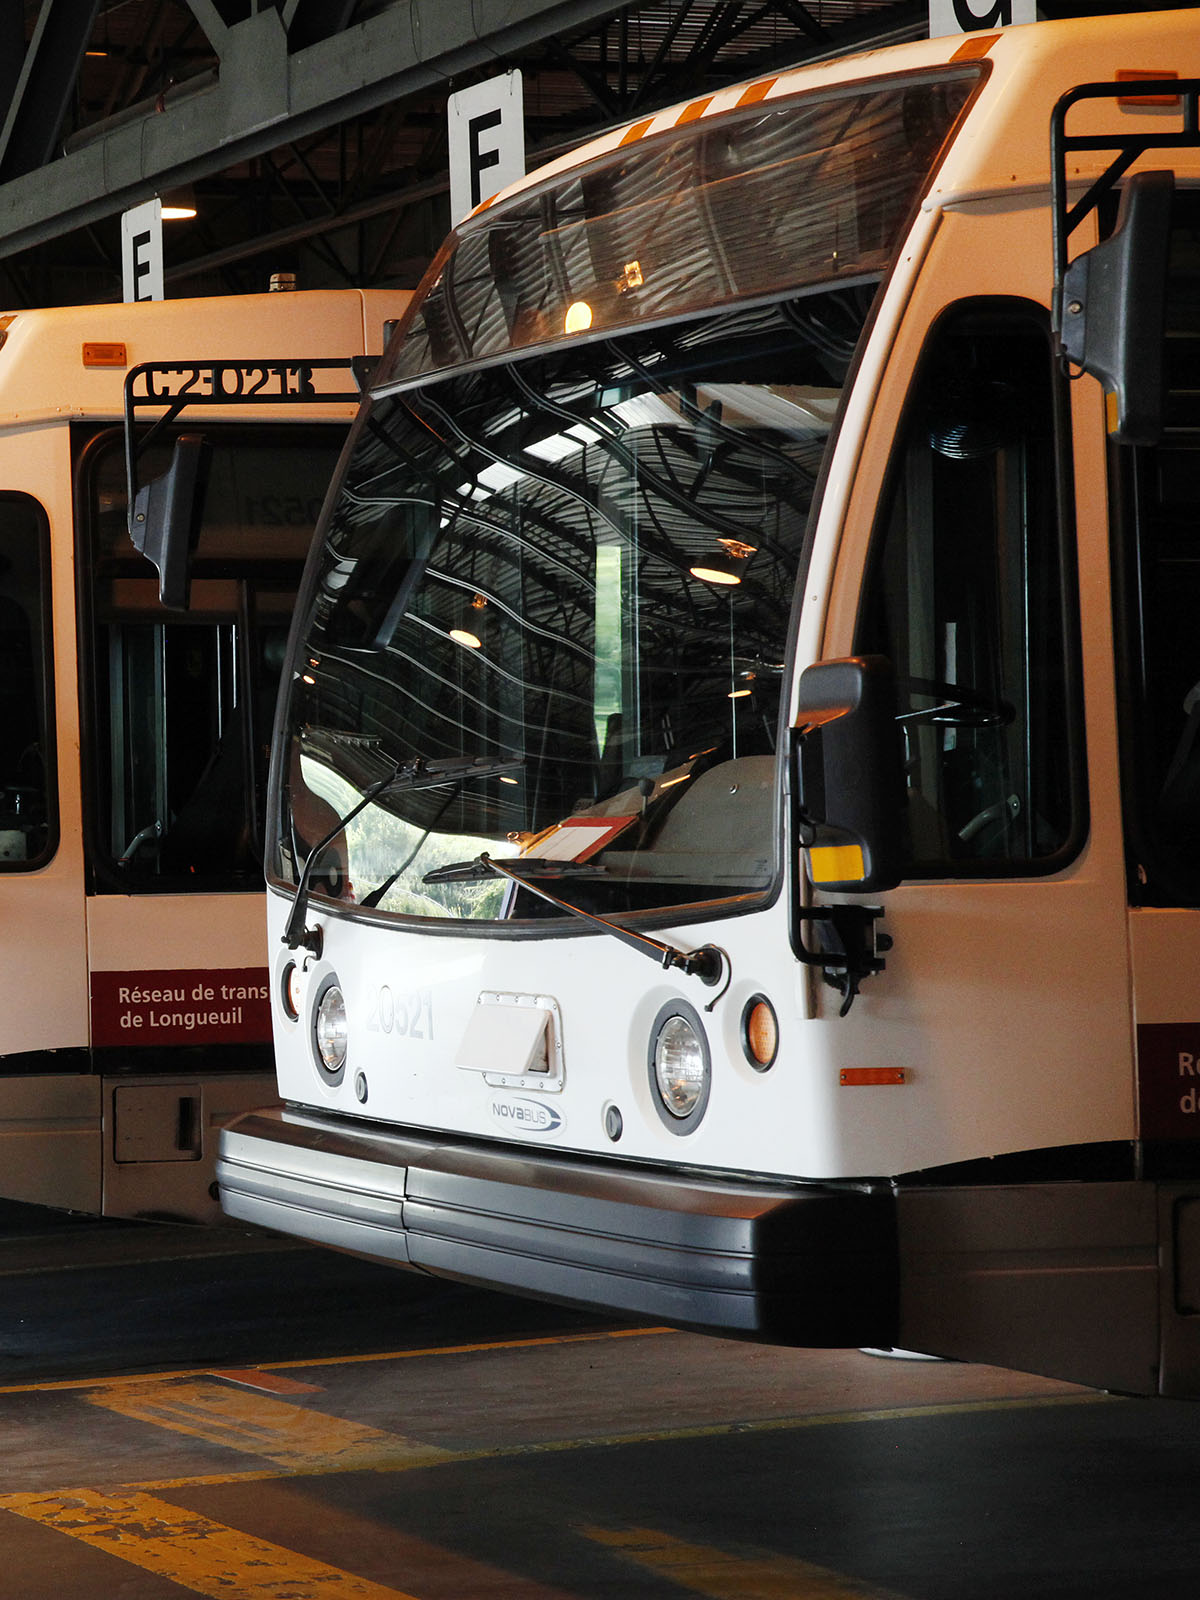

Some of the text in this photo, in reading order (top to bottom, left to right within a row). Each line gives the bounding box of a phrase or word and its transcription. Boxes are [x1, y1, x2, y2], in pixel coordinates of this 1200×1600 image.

[469, 108, 502, 210] F
[132, 230, 152, 303] E
[119, 983, 269, 1004] Réseau de trans
[120, 1006, 243, 1031] de Longueuil
[366, 984, 434, 1041] 20521
[1178, 1051, 1200, 1076] R
[1179, 1087, 1200, 1114] d
